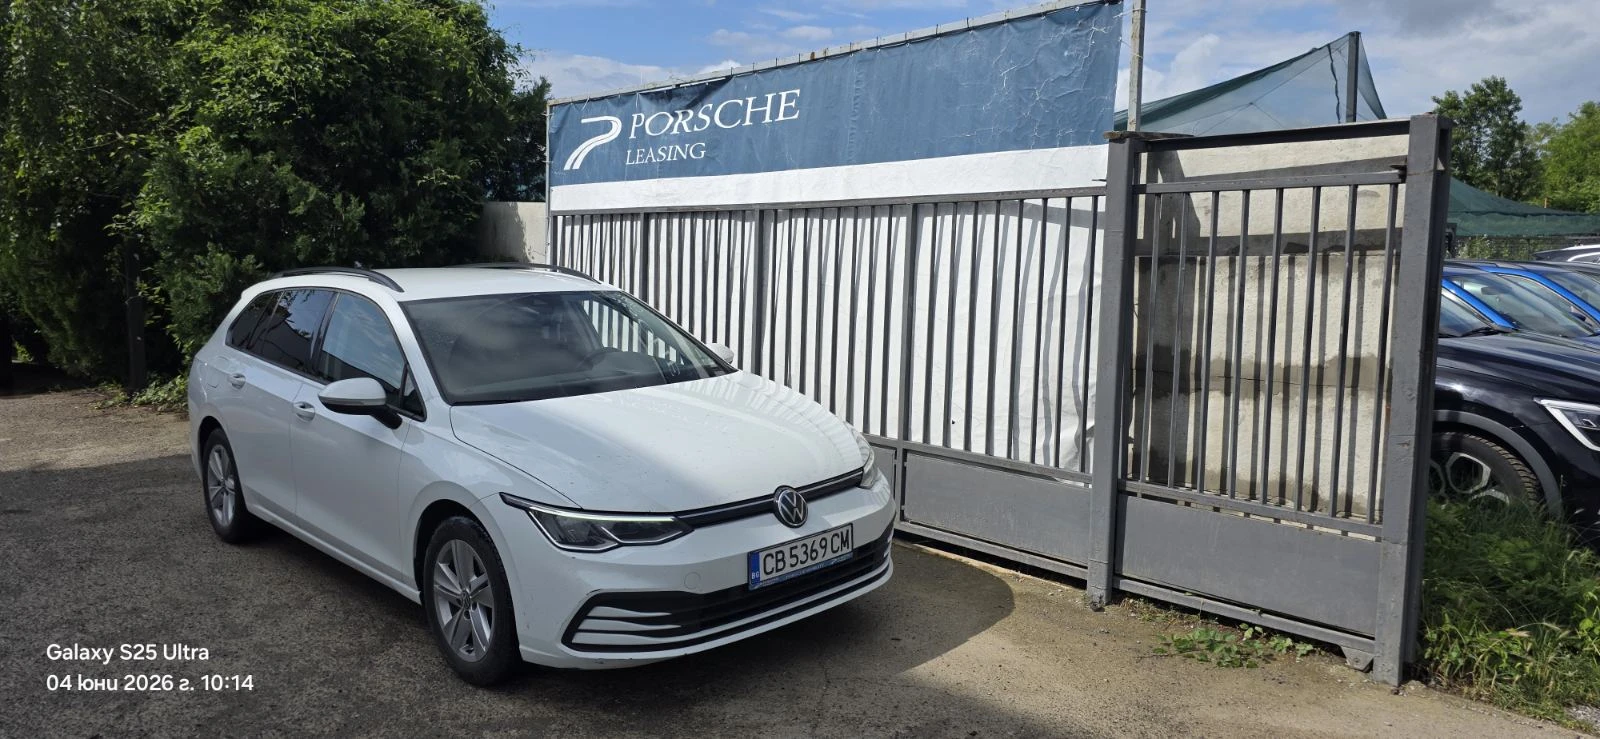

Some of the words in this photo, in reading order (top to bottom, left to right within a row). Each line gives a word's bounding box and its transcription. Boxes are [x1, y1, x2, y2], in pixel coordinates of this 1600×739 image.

[628, 88, 801, 139] PORSCHE
[625, 142, 706, 165] LEASING
[763, 549, 786, 575] CB
[789, 537, 828, 568] 5369
[830, 529, 850, 554] CM
[751, 571, 760, 579] BG
